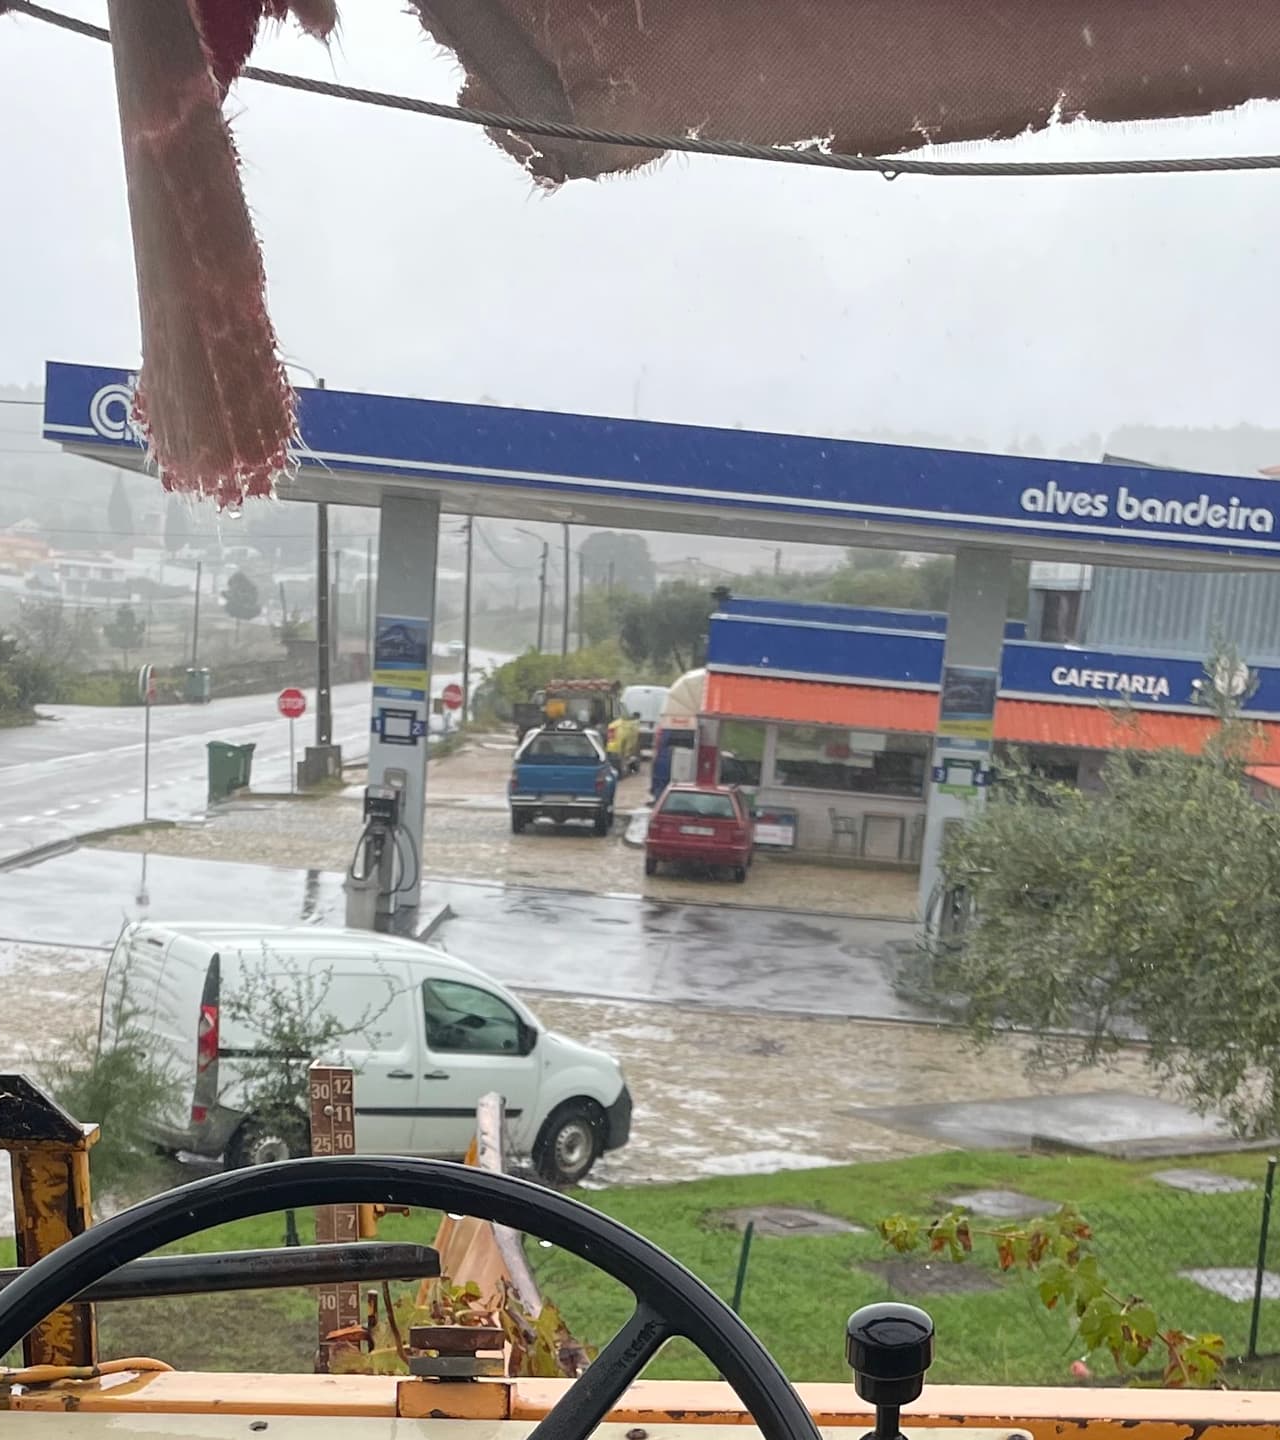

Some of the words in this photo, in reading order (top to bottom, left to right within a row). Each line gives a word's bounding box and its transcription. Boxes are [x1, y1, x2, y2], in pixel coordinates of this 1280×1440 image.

[1021, 480, 1109, 517] alves
[1116, 486, 1275, 533] bandeira
[1051, 667, 1170, 697] CAFETARIA
[311, 1083, 329, 1099] 30
[333, 1079, 352, 1094] 12
[336, 1106, 351, 1122] 11
[313, 1137, 332, 1153] 25
[336, 1133, 353, 1149] 10
[346, 1214, 356, 1230] 7
[321, 1294, 336, 1310] 10
[348, 1294, 357, 1309] 4
